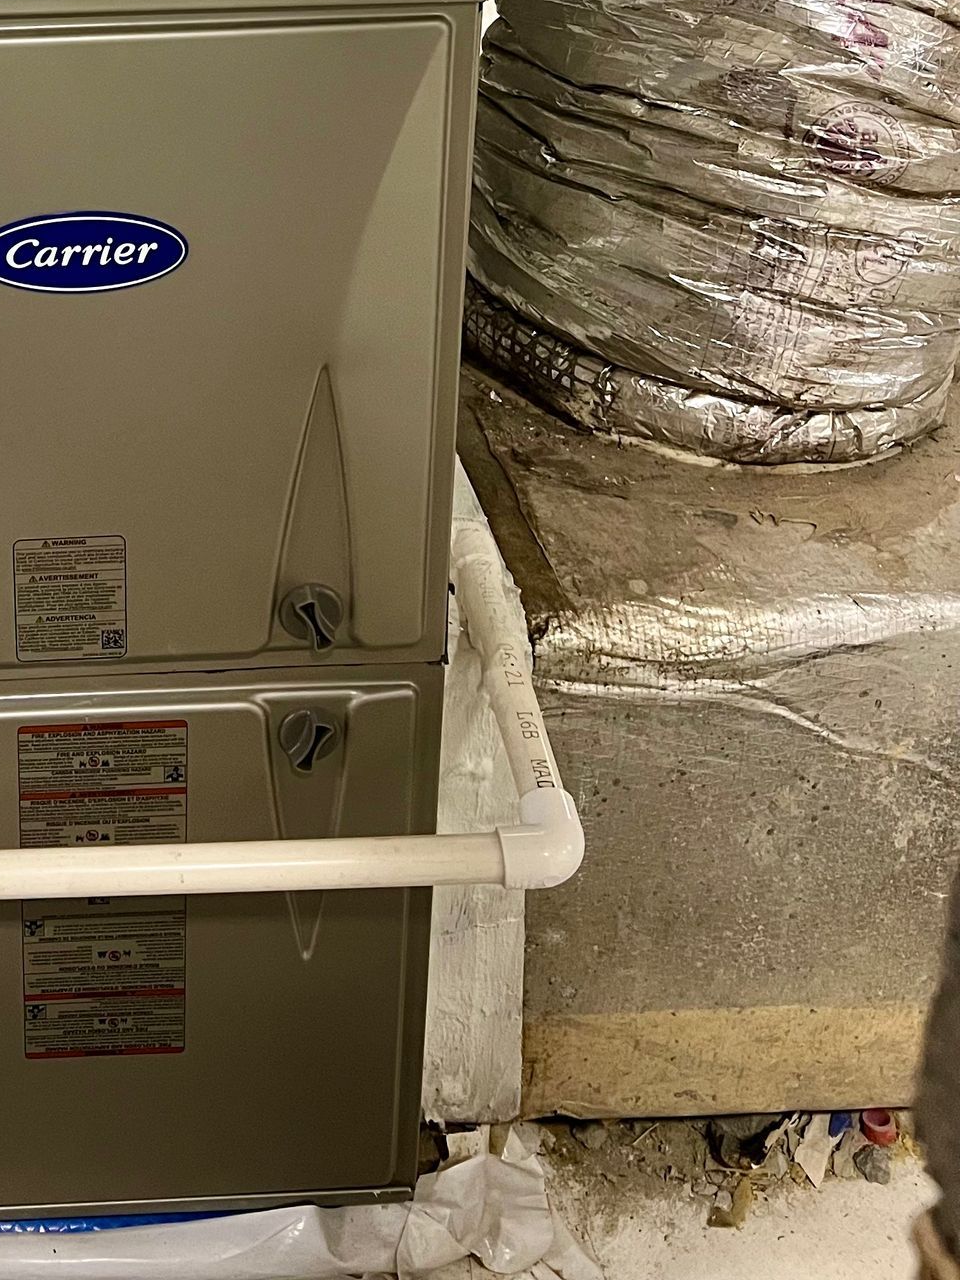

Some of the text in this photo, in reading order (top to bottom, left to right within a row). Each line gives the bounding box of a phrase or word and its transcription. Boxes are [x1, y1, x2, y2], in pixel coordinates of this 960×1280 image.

[6, 237, 158, 268] Carrier
[39, 573, 98, 582] AVERTISSEMENT
[516, 711, 540, 740] L6B
